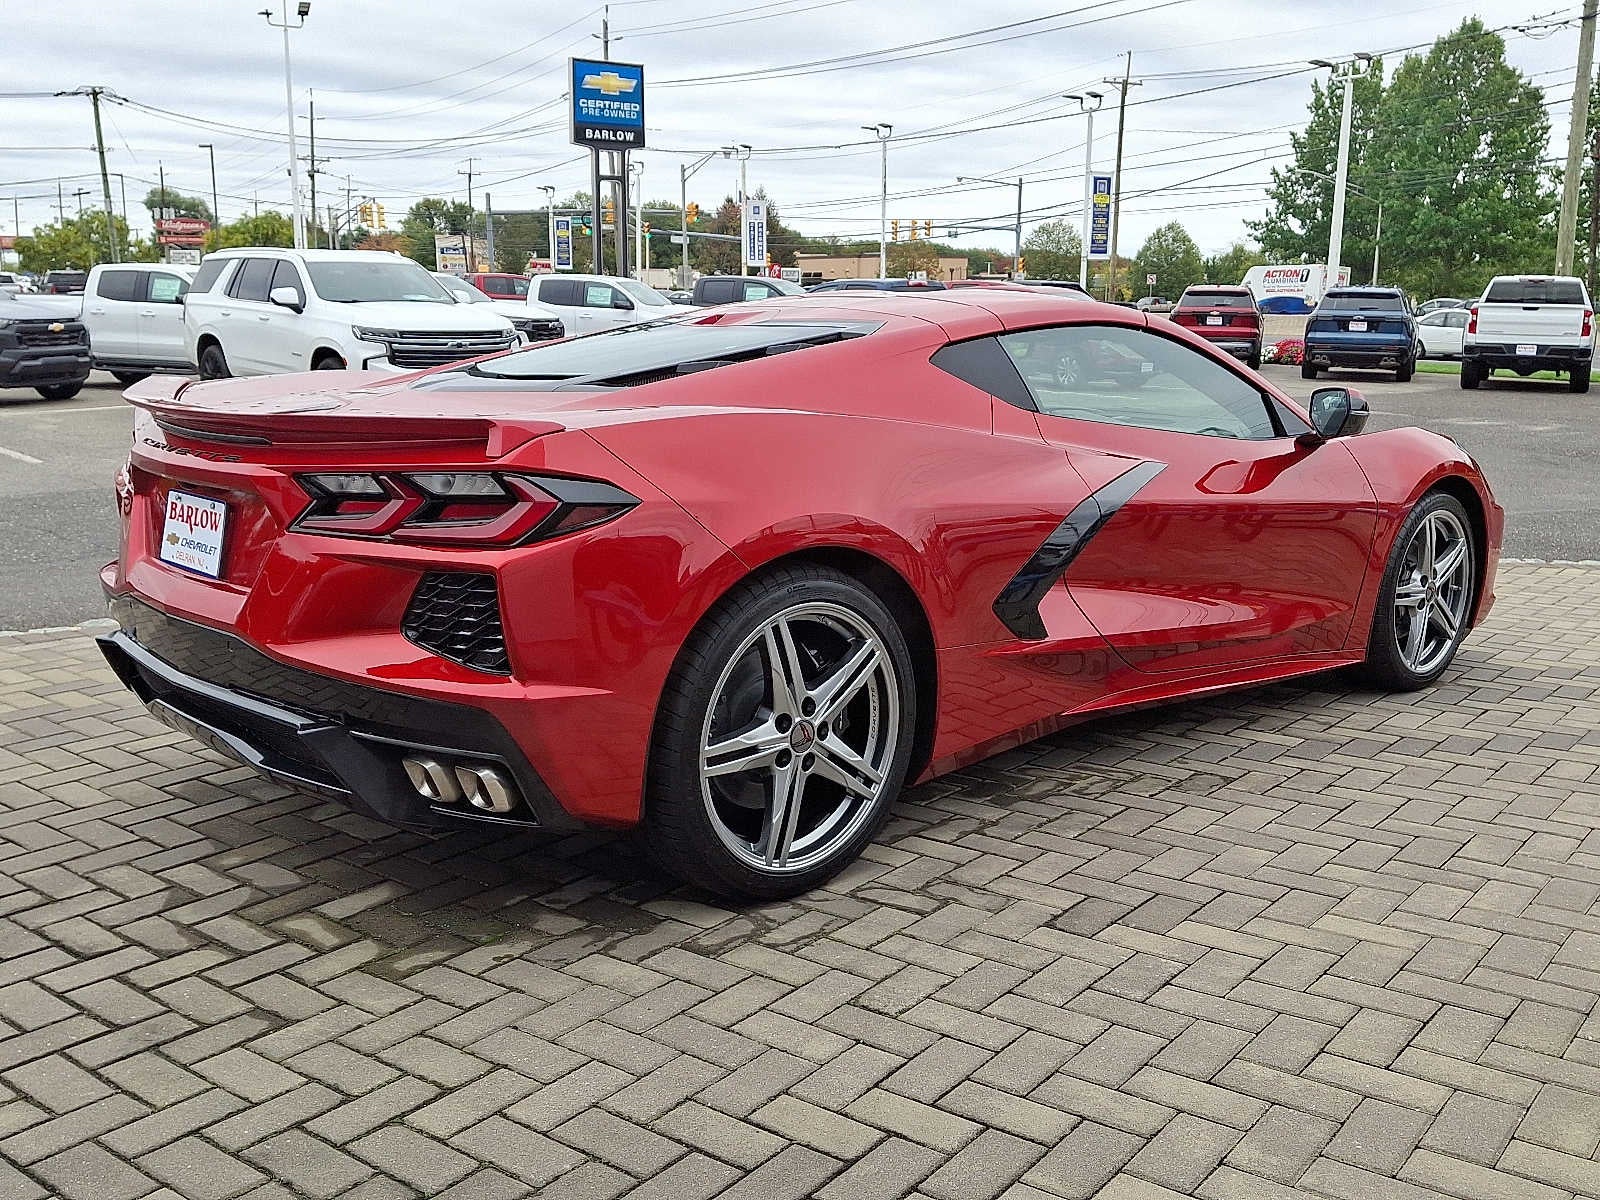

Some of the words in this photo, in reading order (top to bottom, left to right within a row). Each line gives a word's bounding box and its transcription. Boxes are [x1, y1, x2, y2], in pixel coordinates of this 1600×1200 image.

[579, 99, 640, 111] CERTIFIED
[582, 108, 637, 119] PRE-OWNED
[585, 129, 635, 141] BARLOW
[1264, 269, 1301, 278] ACTION
[1300, 268, 1310, 282] 1
[143, 438, 241, 462] CORVETTE
[169, 501, 221, 535] BARLOW
[181, 537, 217, 555] CHEVROLET
